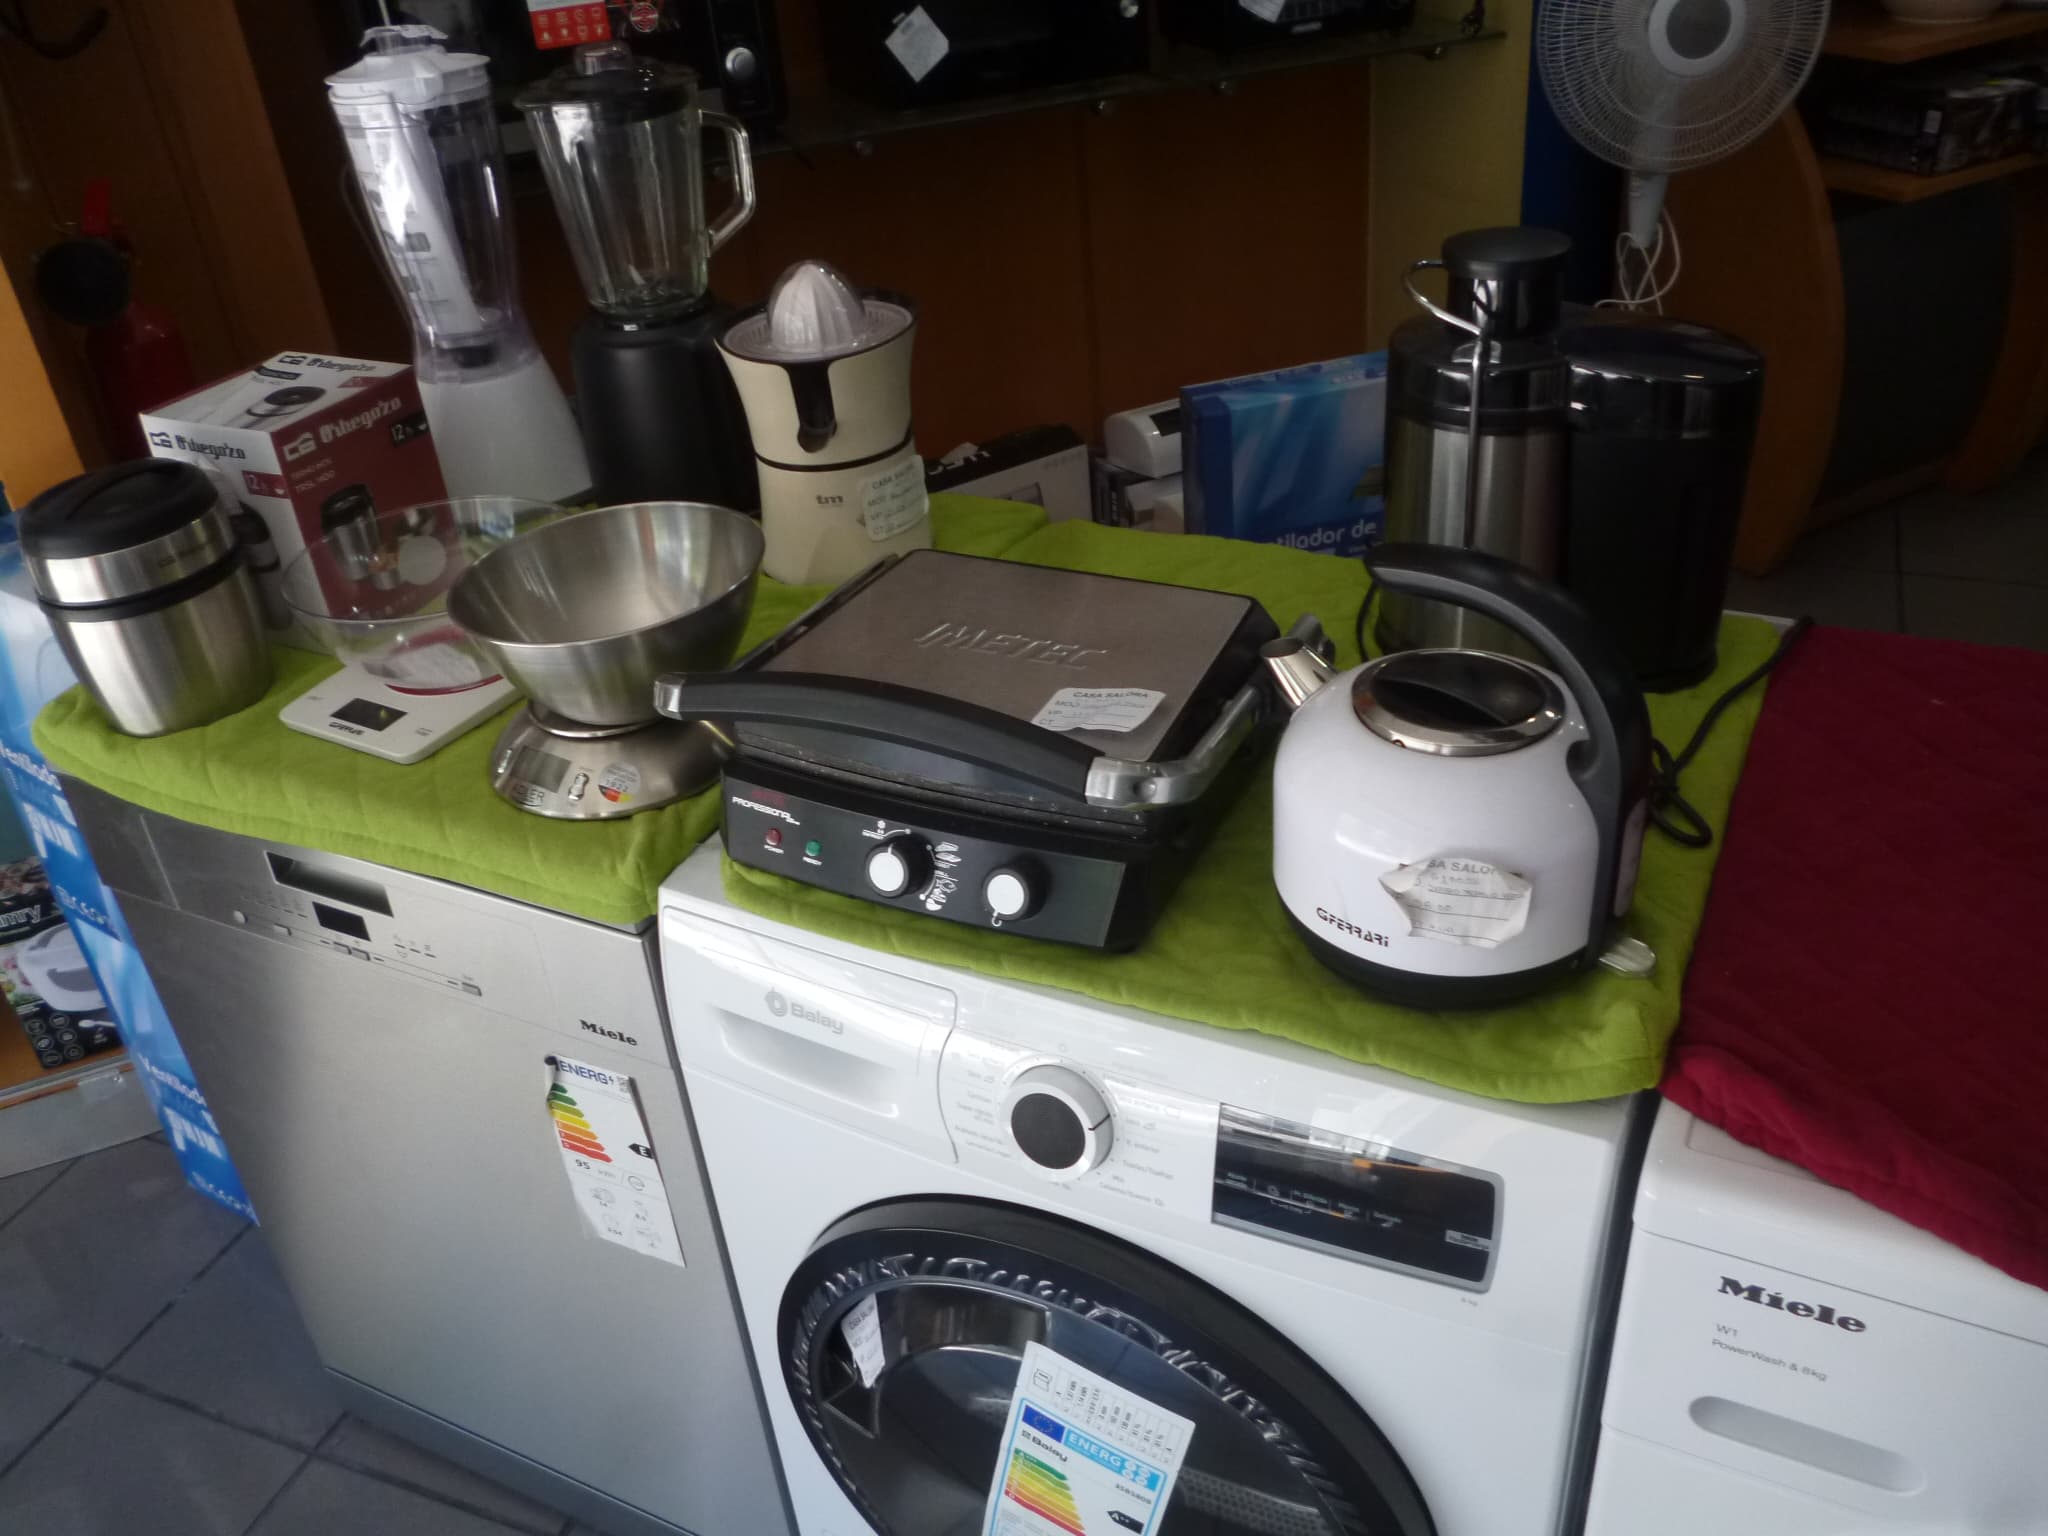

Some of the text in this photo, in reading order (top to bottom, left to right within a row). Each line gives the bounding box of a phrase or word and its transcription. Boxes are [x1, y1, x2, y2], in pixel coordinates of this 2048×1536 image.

[1352, 519, 1377, 538] de
[579, 1018, 639, 1046] Miele
[790, 1001, 844, 1035] Balay
[560, 1060, 609, 1085] ENERG
[1716, 1275, 1868, 1333] Miele
[1711, 1338, 1787, 1368] PowerWash
[1031, 1434, 1069, 1463] Balay
[1068, 1433, 1122, 1466] ENERG
